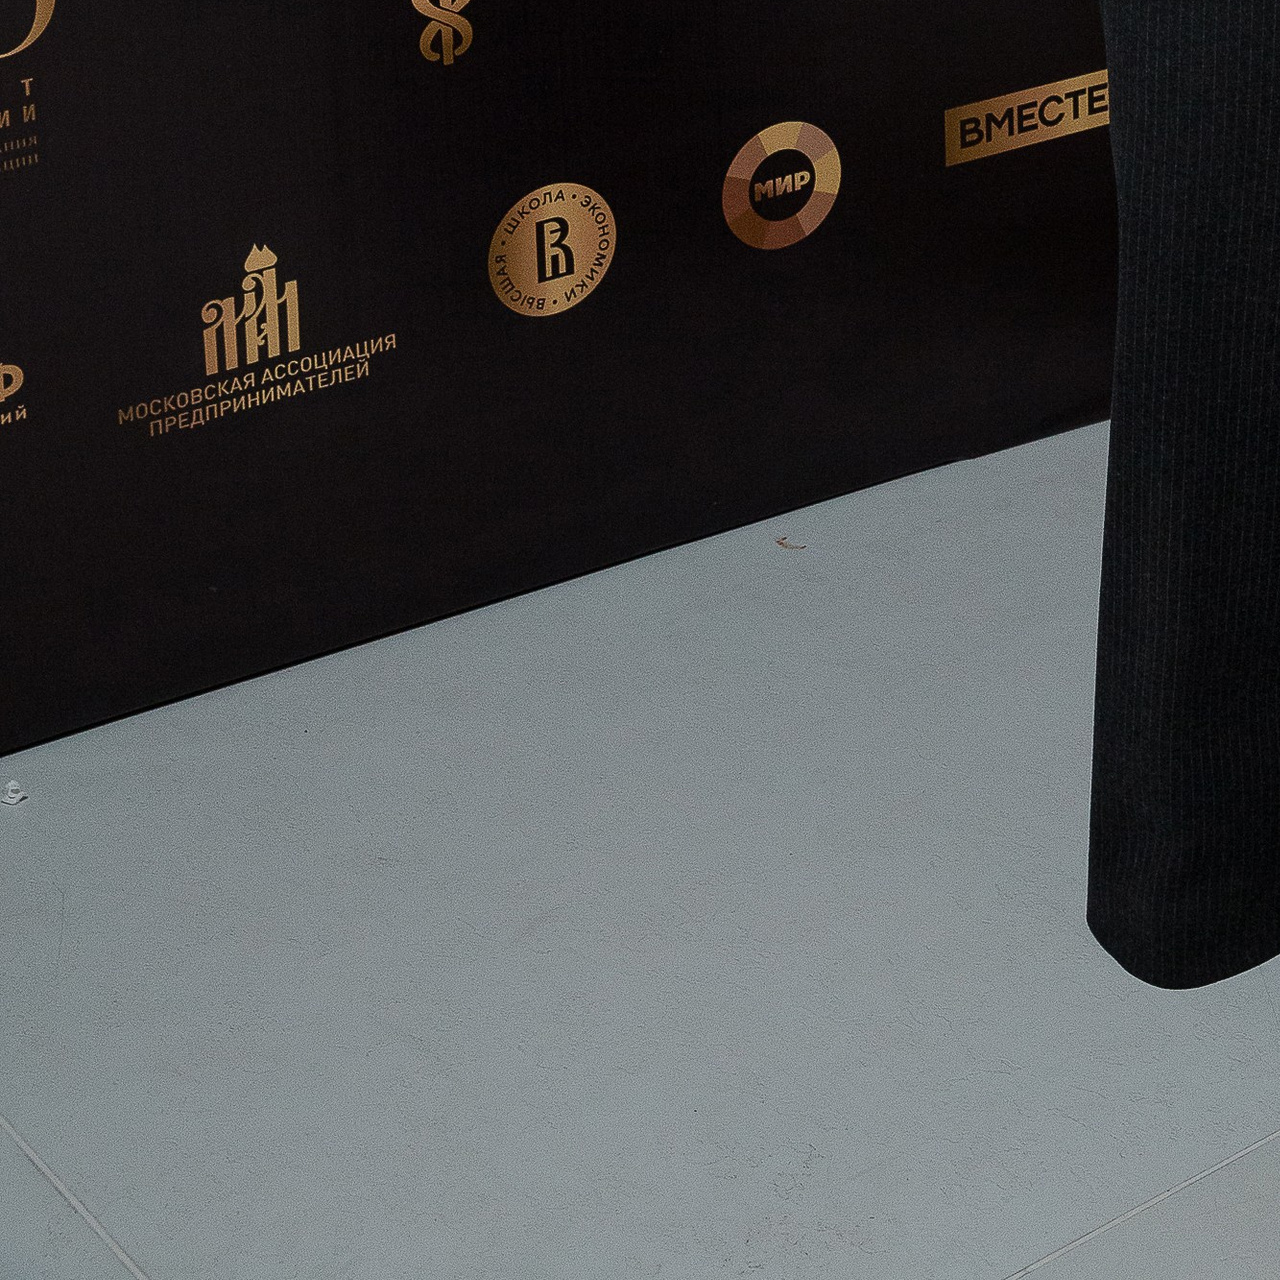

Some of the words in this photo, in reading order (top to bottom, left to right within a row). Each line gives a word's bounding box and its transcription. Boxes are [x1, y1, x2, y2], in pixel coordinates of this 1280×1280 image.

[958, 81, 1108, 150] ВМЕСТЕ
[504, 190, 565, 235] ШКОЛА
[753, 169, 812, 204] МИР
[495, 254, 546, 310] ВЫСШАЯ
[565, 195, 610, 302] ЭКОНОМИКИ
[117, 371, 256, 426] МОСКОВСКАЯ
[261, 333, 397, 385] АССОЦИАЦИЯ
[149, 359, 371, 438] ПРЕДПРИНИМАТЕЛЕЙ
